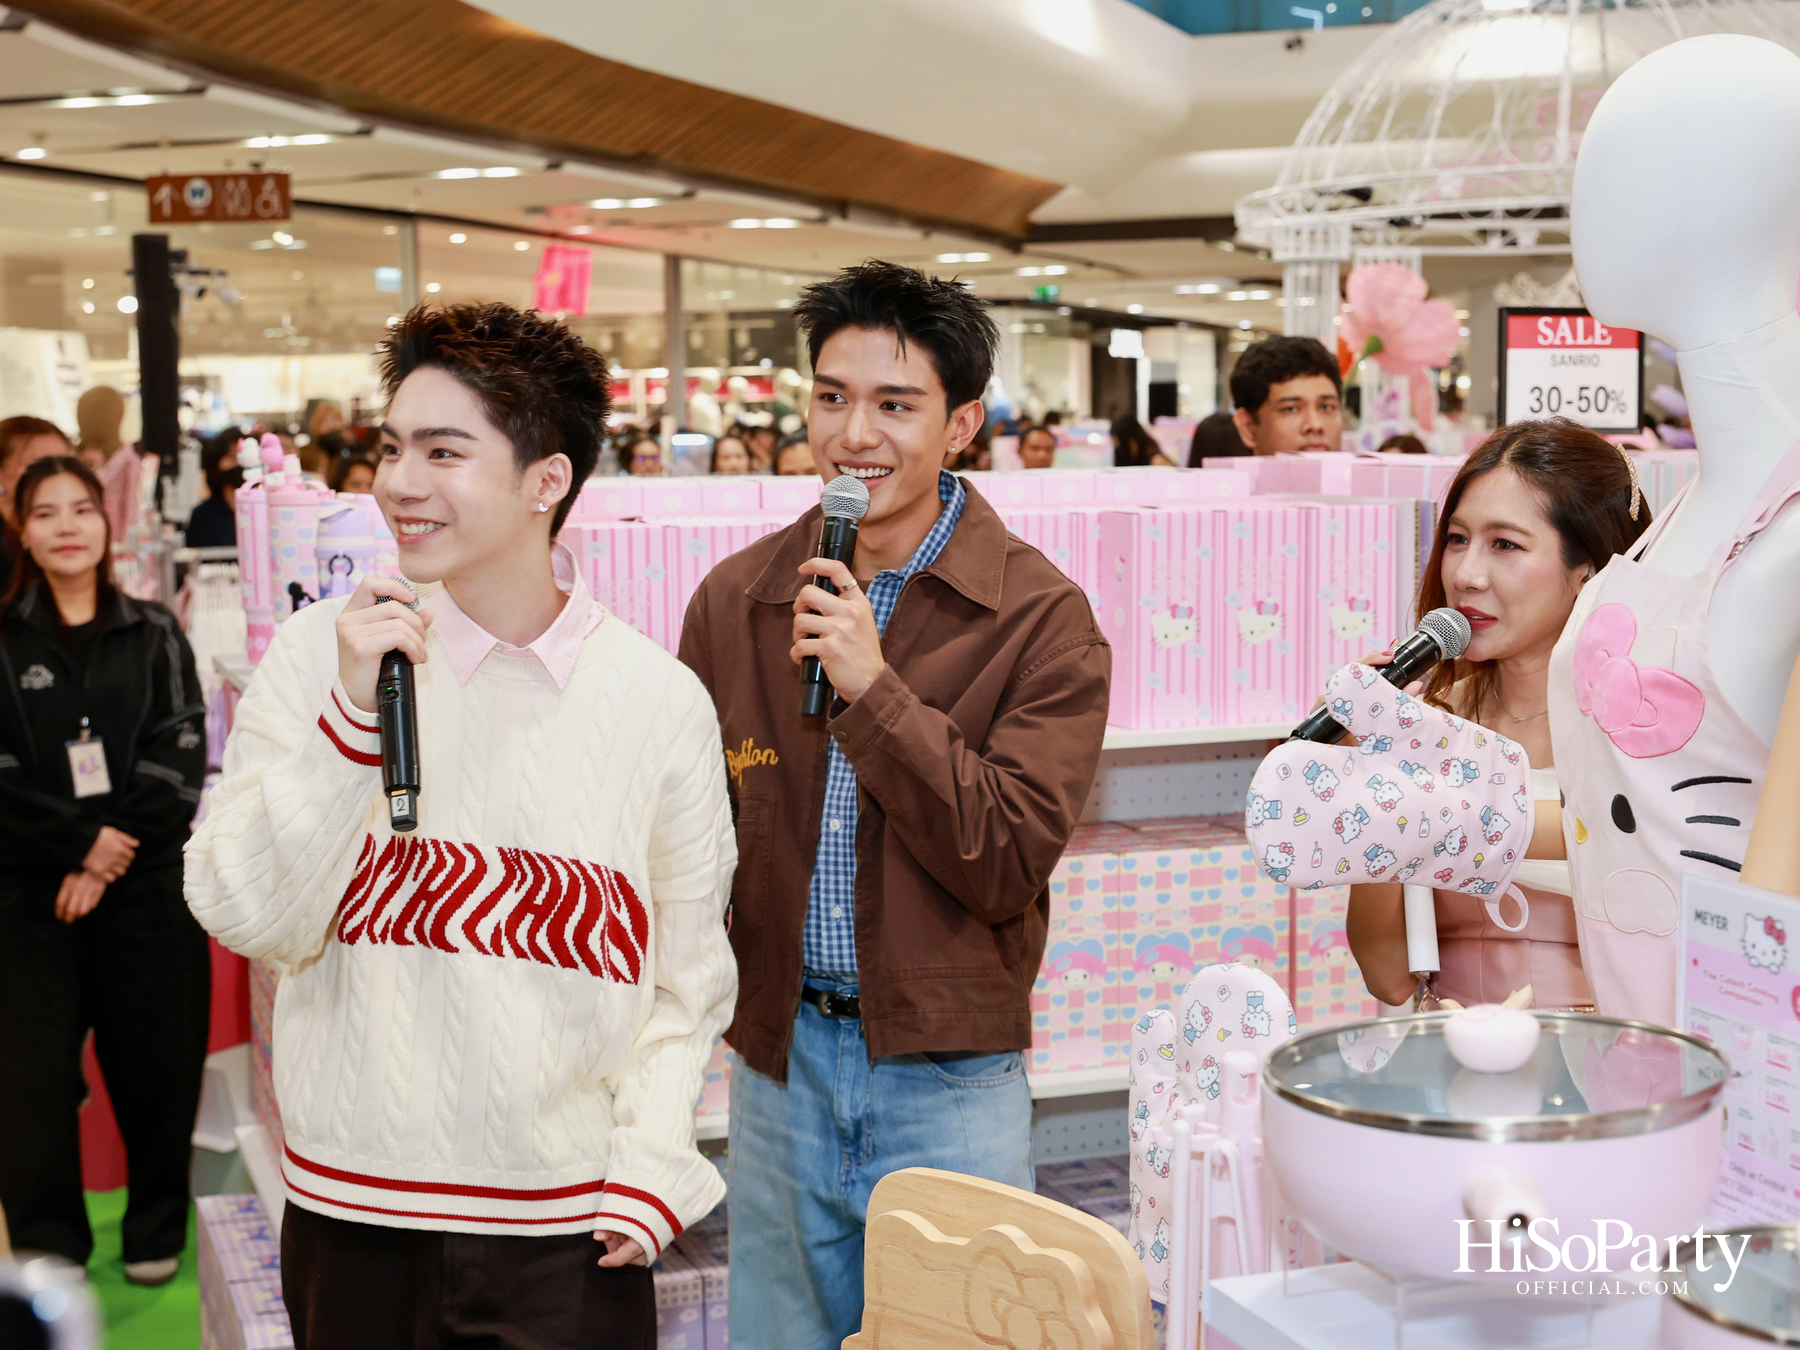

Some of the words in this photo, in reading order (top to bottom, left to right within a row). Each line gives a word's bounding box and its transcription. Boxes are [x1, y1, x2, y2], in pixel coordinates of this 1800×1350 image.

[1537, 316, 1612, 346] SALE
[1551, 353, 1599, 367] SANRIO
[1529, 386, 1628, 414] 30-50%
[396, 797, 406, 812] 2
[1694, 909, 1729, 931] MEYER
